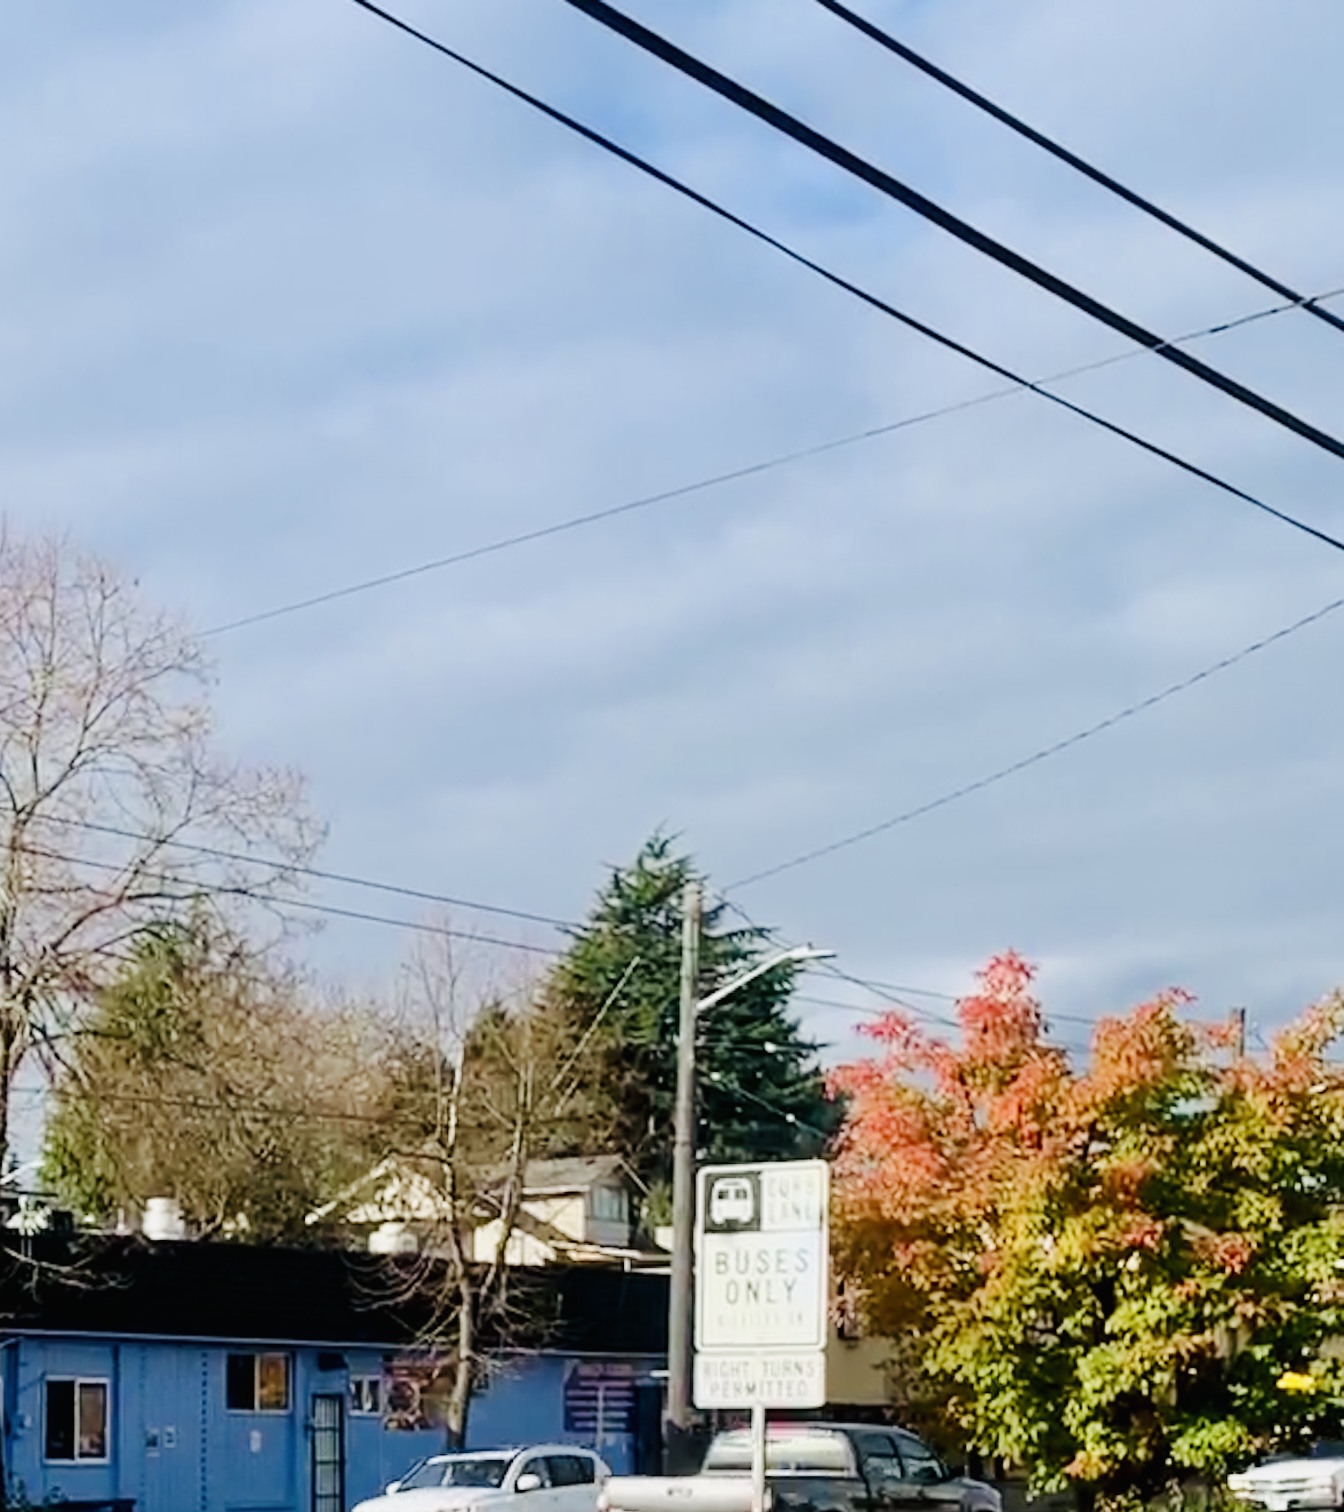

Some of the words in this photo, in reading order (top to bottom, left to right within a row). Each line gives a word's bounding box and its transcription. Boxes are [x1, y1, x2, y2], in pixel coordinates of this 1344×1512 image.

[714, 1247, 810, 1276] BUSES
[725, 1277, 798, 1306] ONLY
[703, 1360, 750, 1379] RIGHT
[762, 1359, 816, 1379] TURNS
[710, 1379, 809, 1399] PERMITTED
